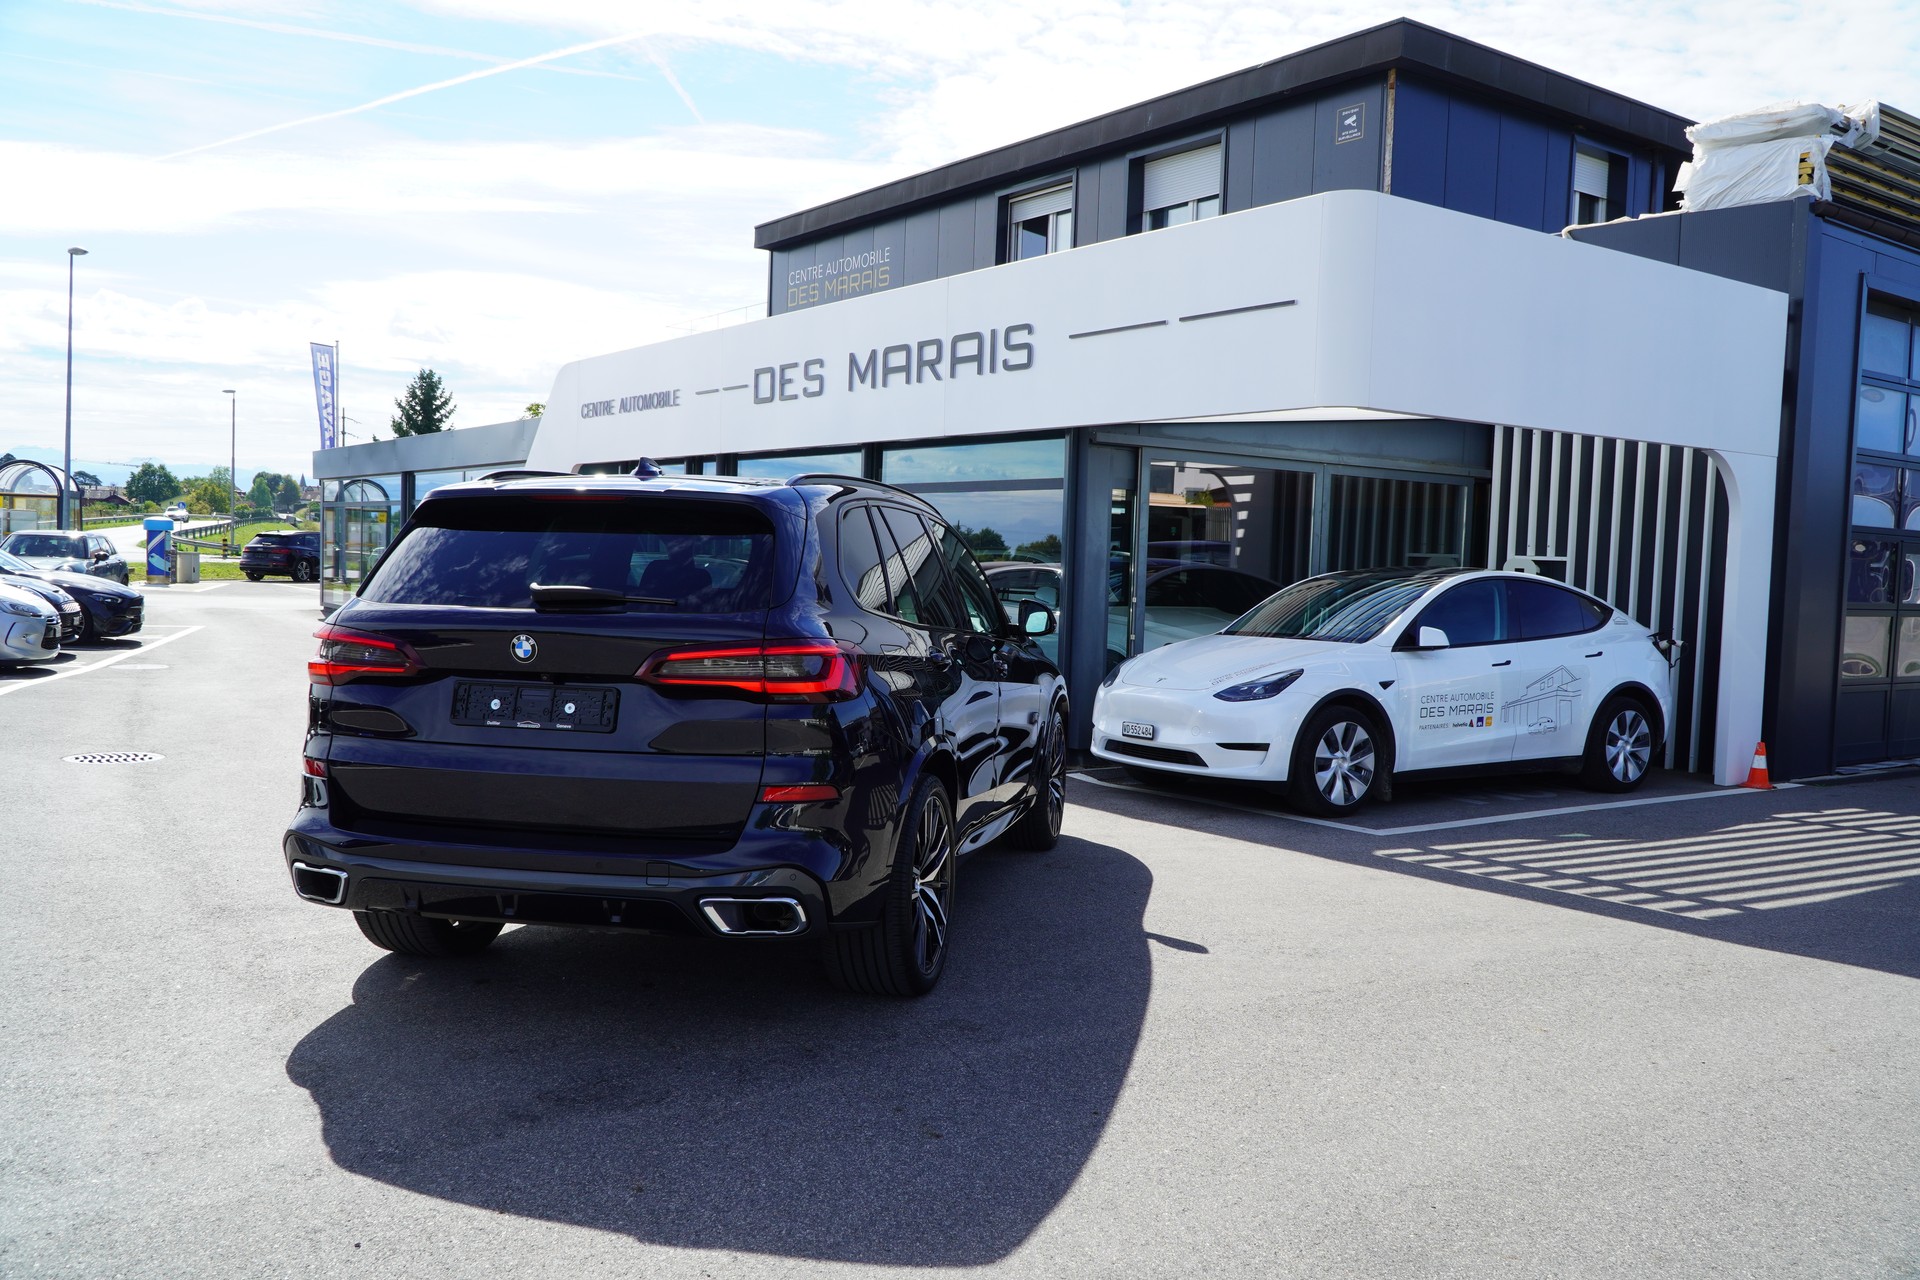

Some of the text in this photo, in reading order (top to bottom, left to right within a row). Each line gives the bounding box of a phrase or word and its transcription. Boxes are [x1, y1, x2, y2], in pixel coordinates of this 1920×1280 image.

[788, 247, 891, 286] CENTRE AUTOMOBILE
[787, 266, 890, 307] DES MARAIS
[580, 322, 1035, 419] CENTRE AUTOMOBILE DES MARAIS
[1420, 691, 1495, 704] CENTRE AUTOMOBILE
[1420, 702, 1494, 718] DES MARAIS
